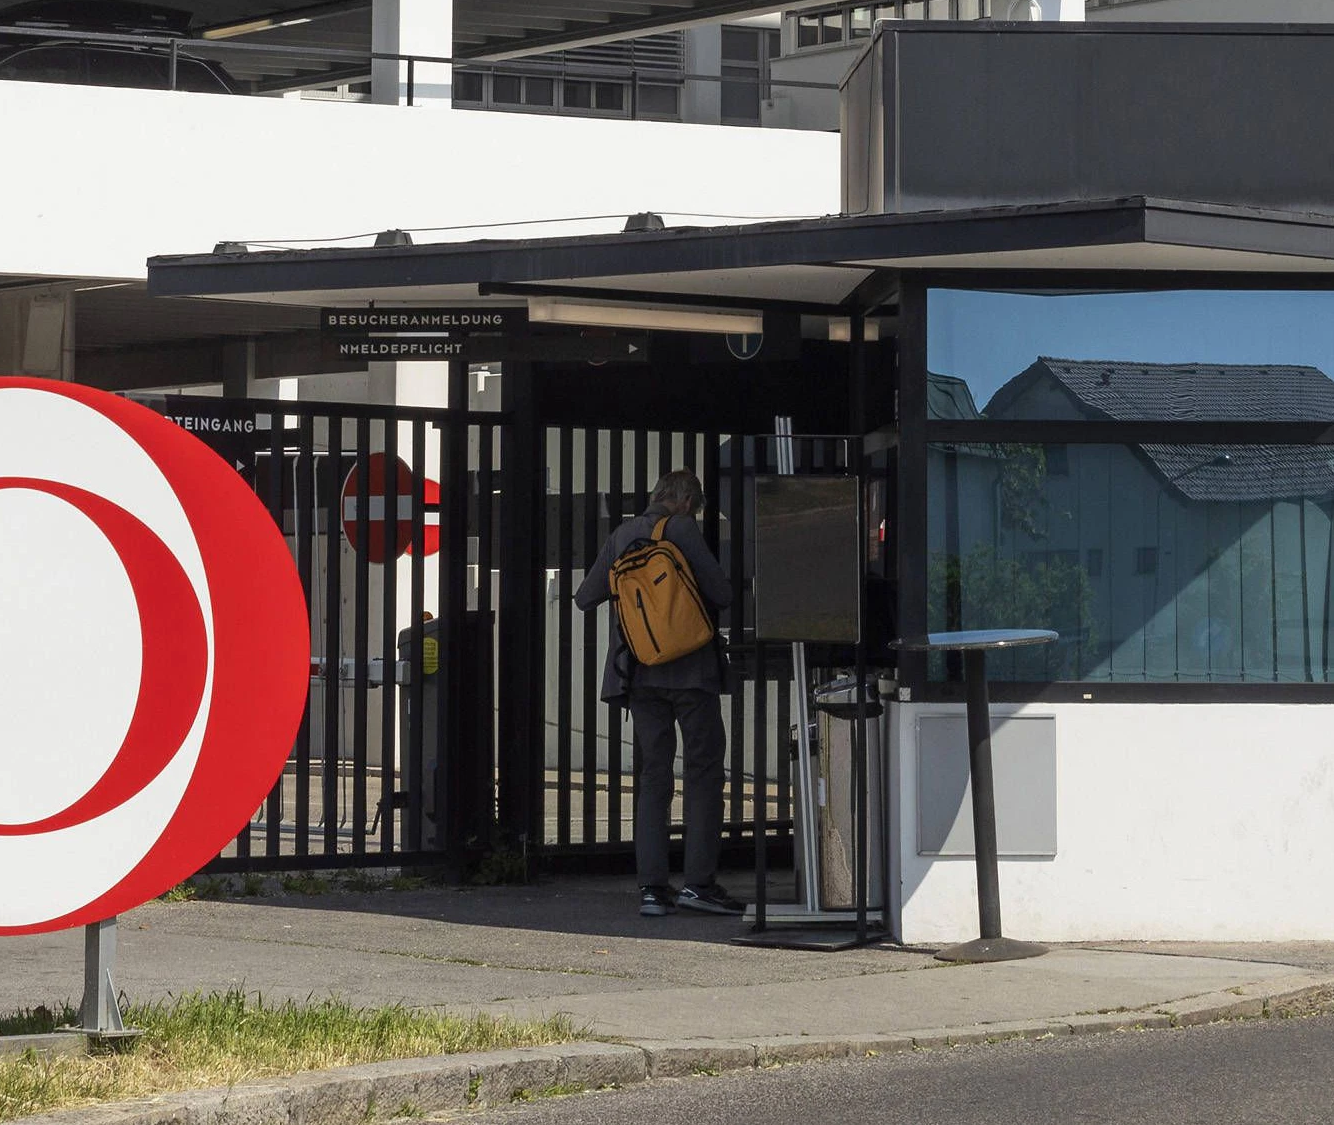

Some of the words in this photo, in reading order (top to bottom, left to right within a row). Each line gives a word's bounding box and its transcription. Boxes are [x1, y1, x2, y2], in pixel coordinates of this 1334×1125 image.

[328, 314, 503, 325] BESUCHERANMELDUNG
[339, 344, 463, 354] NMELDEPFLICHT
[164, 415, 254, 433] TEINGANG
